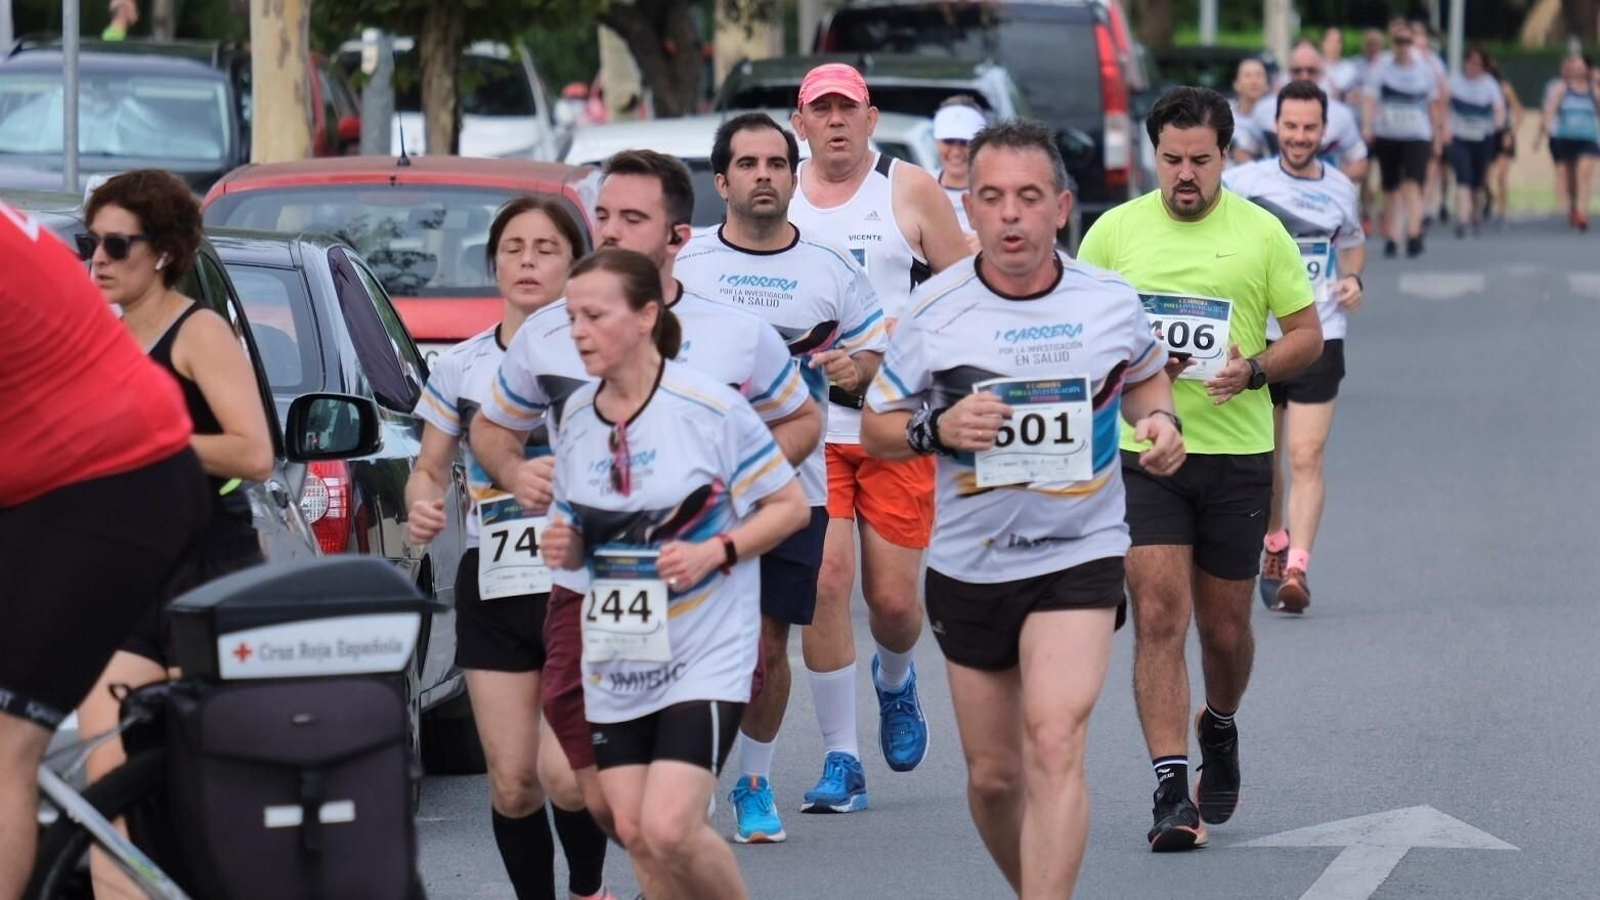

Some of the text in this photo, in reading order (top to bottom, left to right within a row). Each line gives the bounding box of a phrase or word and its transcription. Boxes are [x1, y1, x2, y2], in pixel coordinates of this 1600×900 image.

[848, 234, 882, 242] VICENTE
[727, 275, 798, 291] CARRERA
[732, 296, 780, 308] EN SALUD
[745, 290, 793, 301] INVESTIGACIÓN
[1004, 323, 1083, 344] CARRERA
[1028, 341, 1083, 353] INVESTIGACIÓN
[1015, 351, 1070, 366] EN SALUD
[260, 636, 402, 663] Cruz Roja Española
